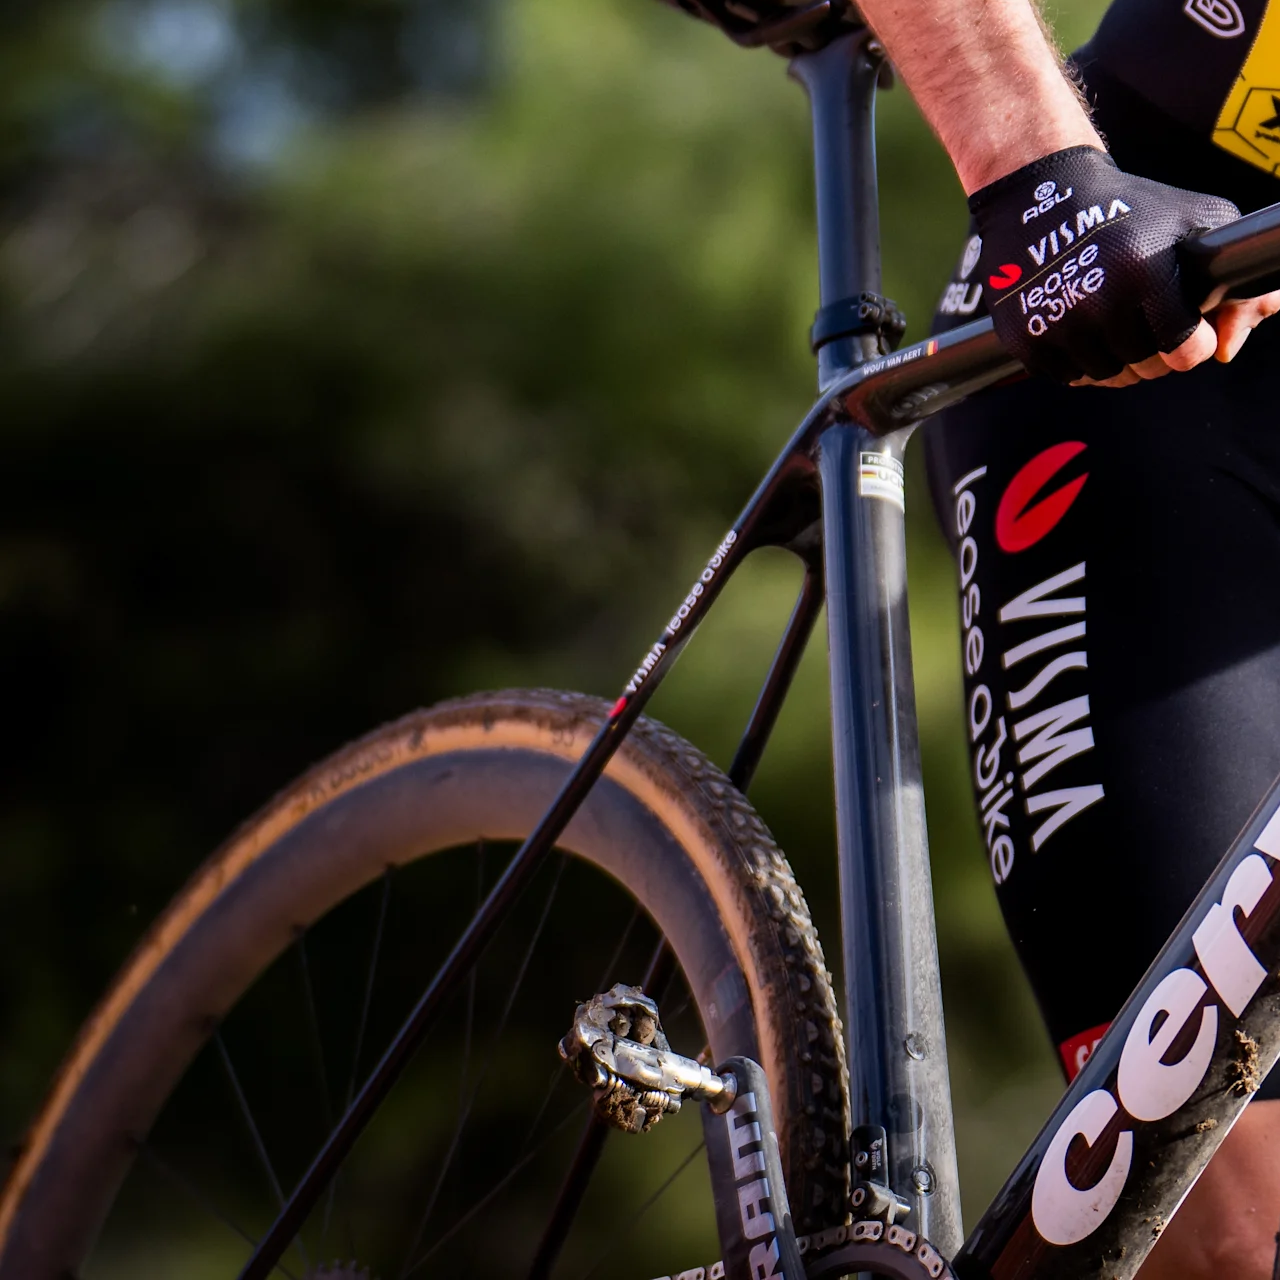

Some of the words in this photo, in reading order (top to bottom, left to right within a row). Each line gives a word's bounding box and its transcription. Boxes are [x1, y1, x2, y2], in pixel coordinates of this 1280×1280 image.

[1022, 187, 1073, 225] AGU
[1028, 198, 1132, 267] VISMA
[1020, 242, 1099, 315] lease
[862, 360, 887, 376] WOUT
[886, 354, 902, 368] VAN
[902, 347, 922, 362] AERT
[953, 465, 988, 675] lease
[625, 641, 667, 694] VISMA
[664, 582, 705, 636] lease
[1000, 560, 1105, 854] VISMA
